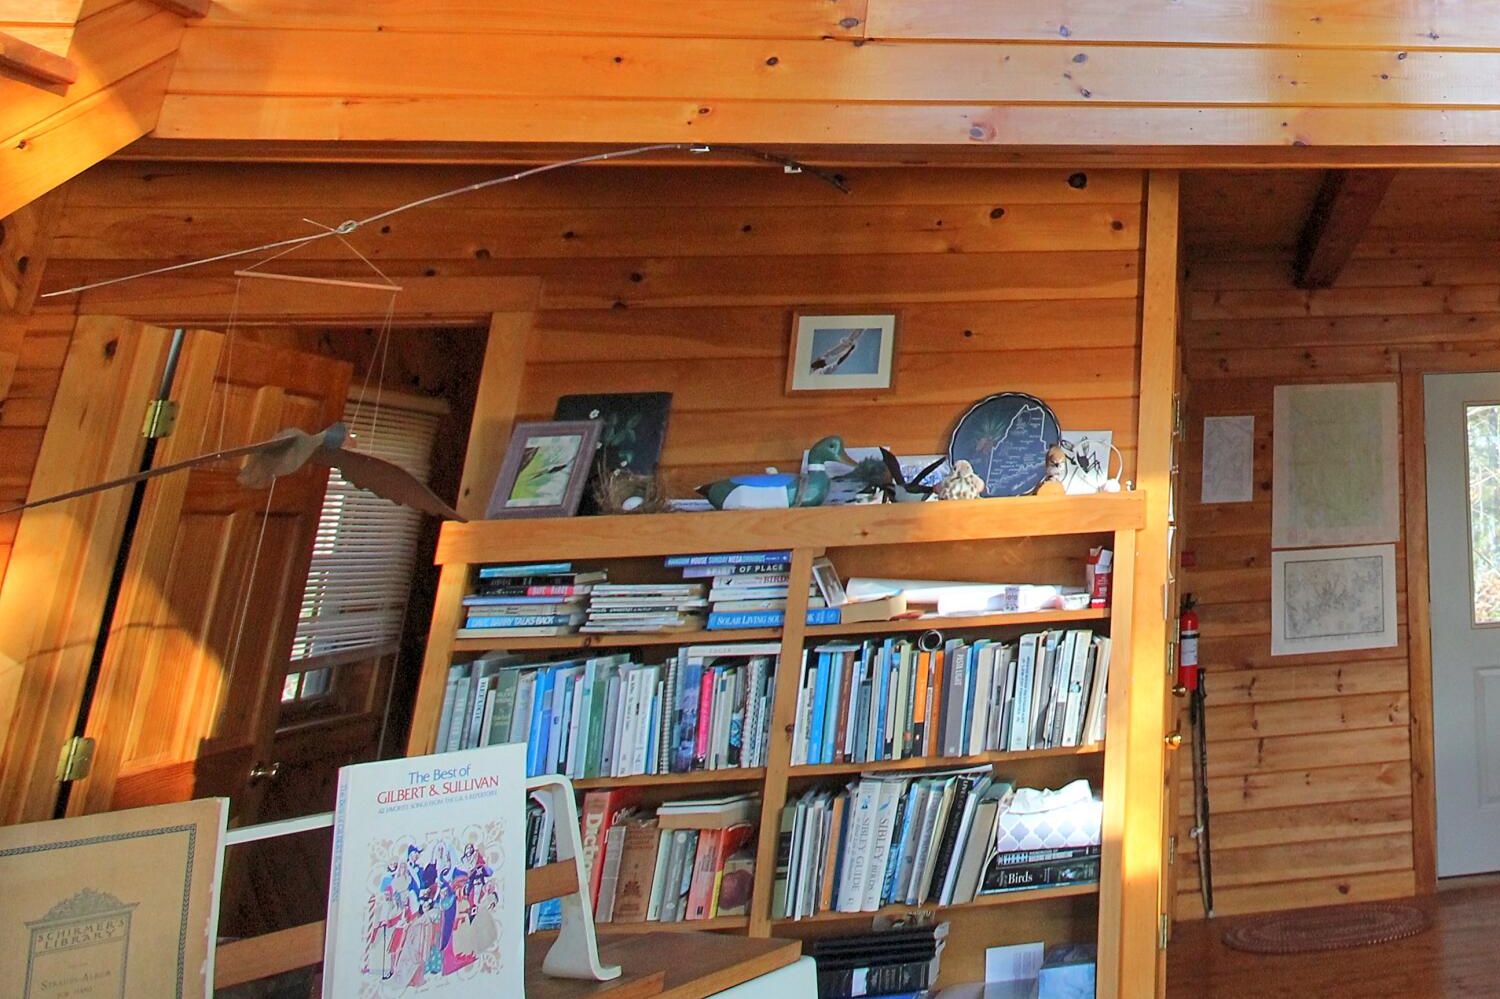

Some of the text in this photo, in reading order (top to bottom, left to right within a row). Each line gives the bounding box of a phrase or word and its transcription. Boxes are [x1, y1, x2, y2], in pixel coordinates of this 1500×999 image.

[739, 565, 752, 573] OF
[754, 564, 784, 573] PLACE
[513, 616, 536, 626] TALKS
[536, 615, 554, 625] BACK
[717, 616, 741, 626] SOLAR
[742, 614, 767, 625] LIVING
[474, 680, 487, 720] REFUGE
[408, 764, 472, 785] The Best of
[377, 775, 500, 805] GILBERT & SULLIVAN
[857, 814, 870, 852] SIBLEY
[874, 817, 889, 861] SIBLEY
[852, 855, 864, 890] GUIDE
[1008, 870, 1033, 884] Birds
[44, 929, 117, 950] LIBRARY
